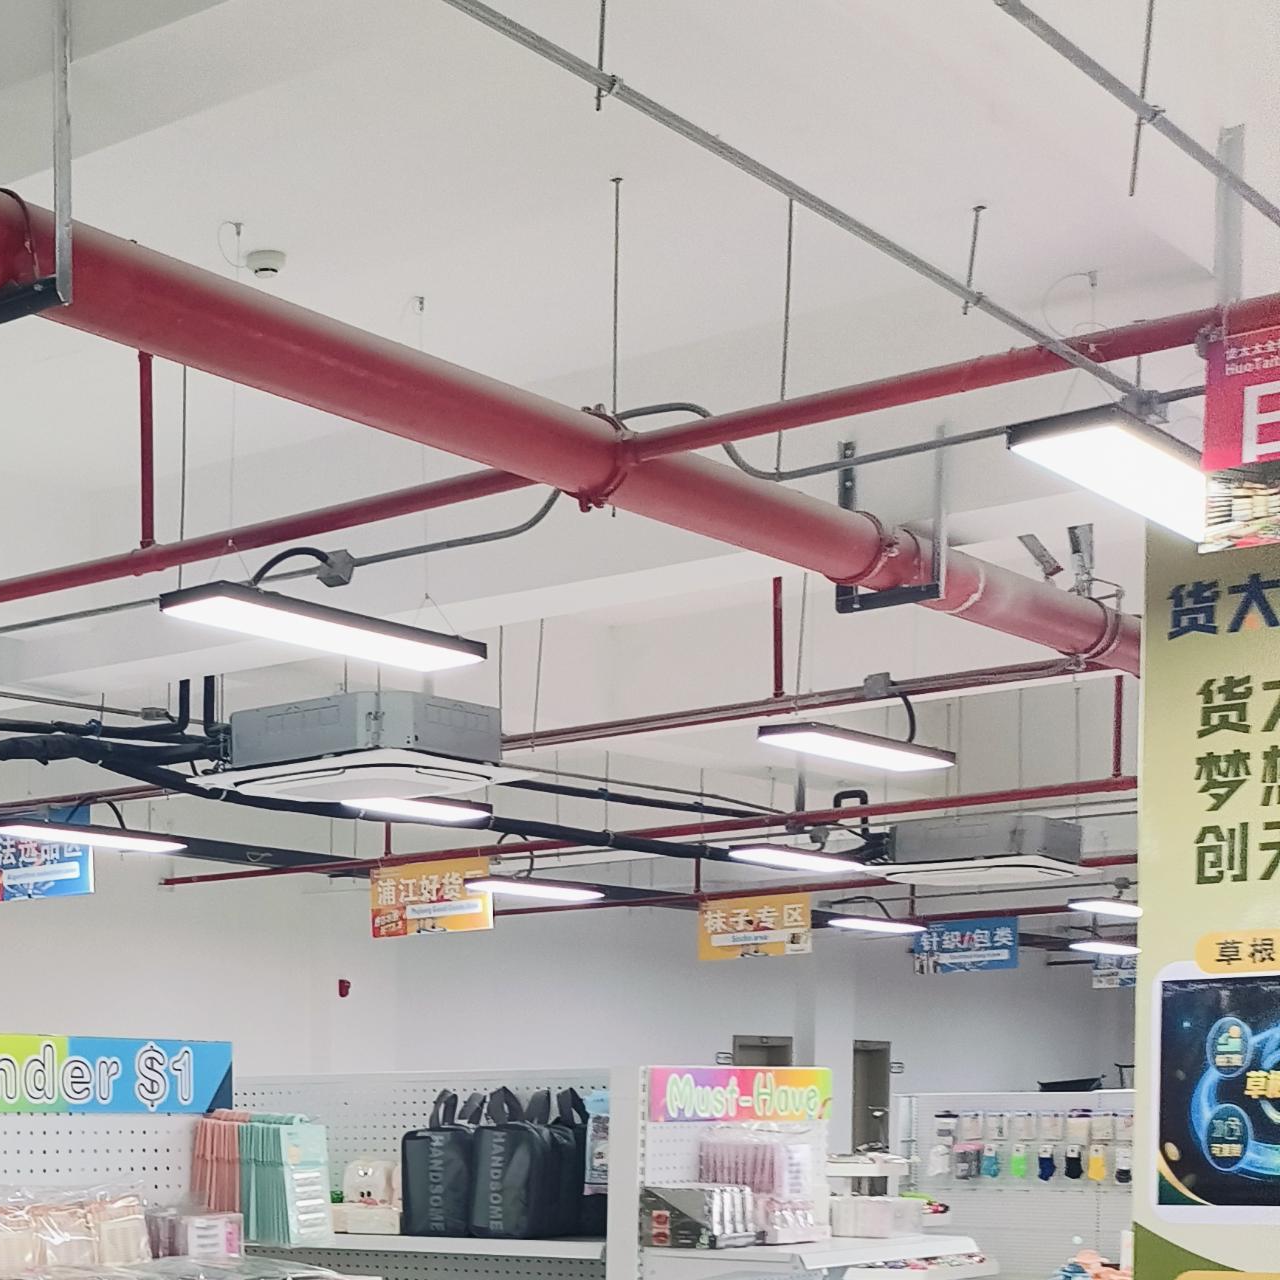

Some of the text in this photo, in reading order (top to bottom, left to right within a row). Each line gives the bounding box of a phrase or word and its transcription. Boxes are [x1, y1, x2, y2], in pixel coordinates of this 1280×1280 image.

[135, 1041, 195, 1112] $1
[665, 1072, 821, 1118] Must-Have
[428, 1135, 446, 1232] HANDSOME
[488, 1131, 505, 1232] HANDSOME
